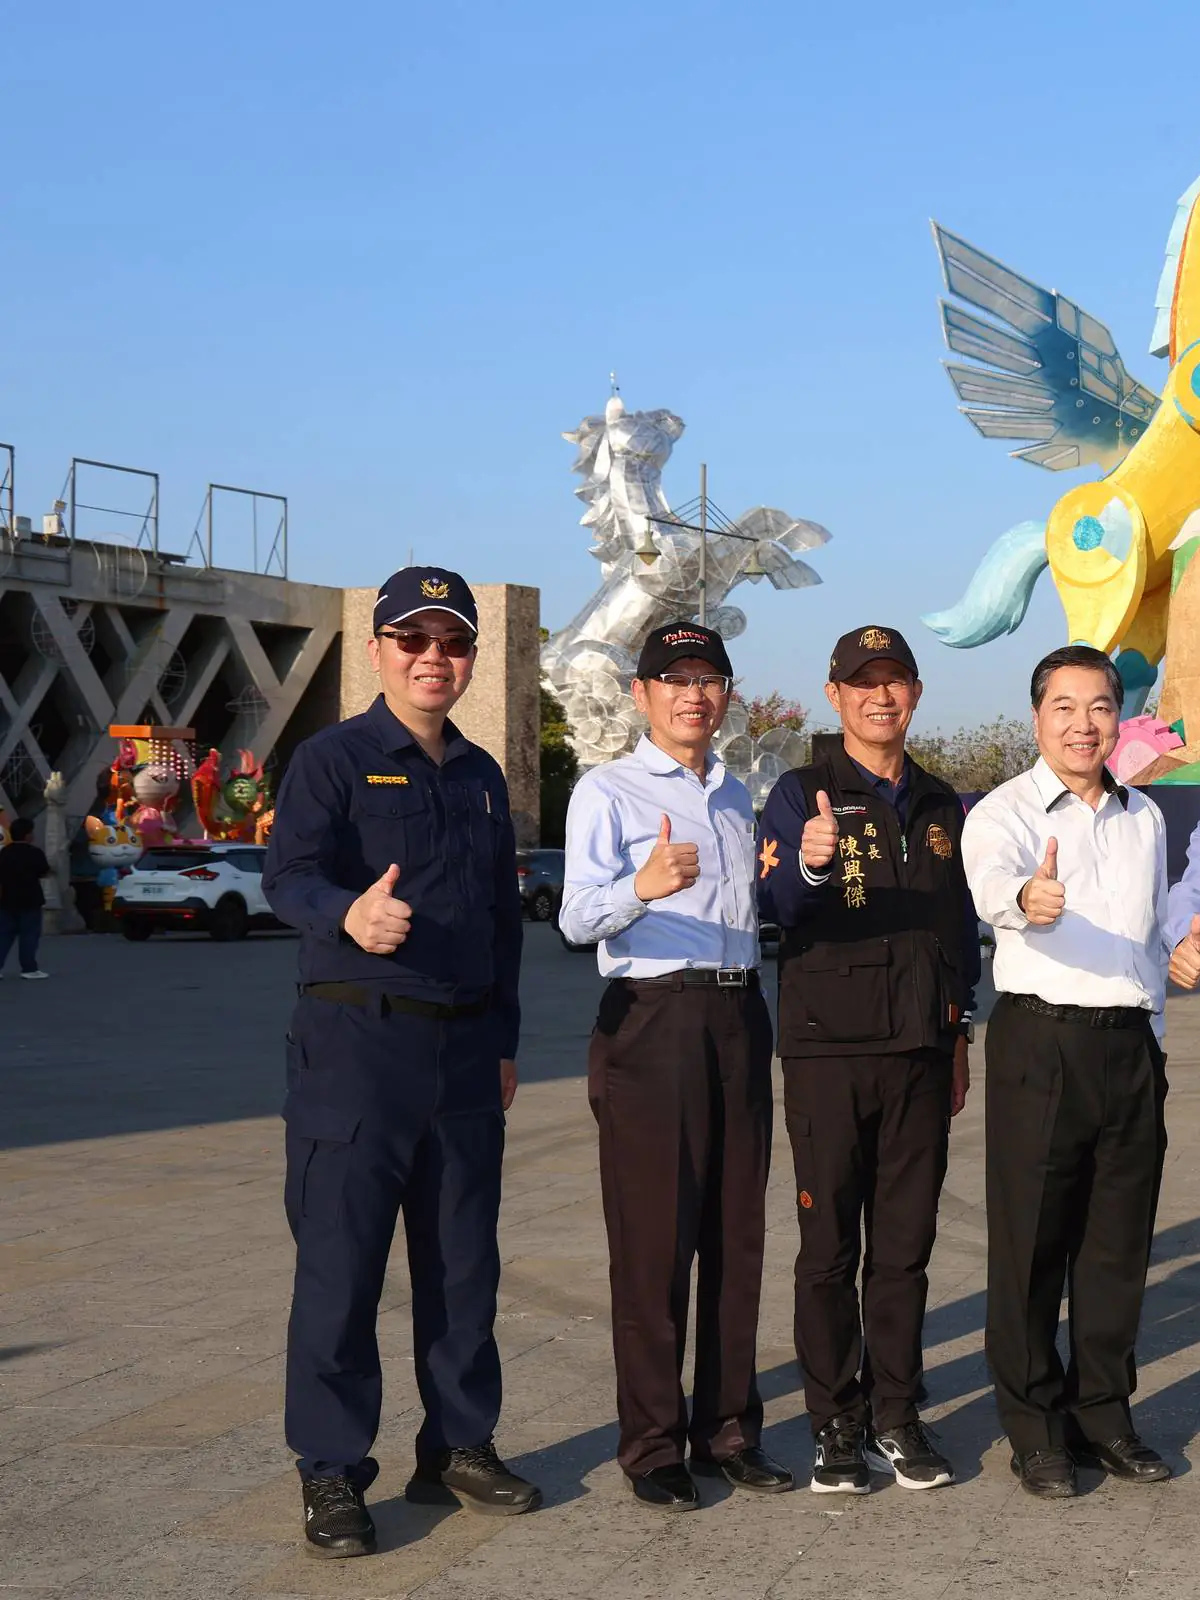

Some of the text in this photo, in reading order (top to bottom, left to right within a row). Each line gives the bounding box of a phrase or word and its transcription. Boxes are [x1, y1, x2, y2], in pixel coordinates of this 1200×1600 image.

[662, 629, 710, 644] Taiwan
[863, 822, 882, 860] 局長
[839, 835, 867, 909] 陳興傑
